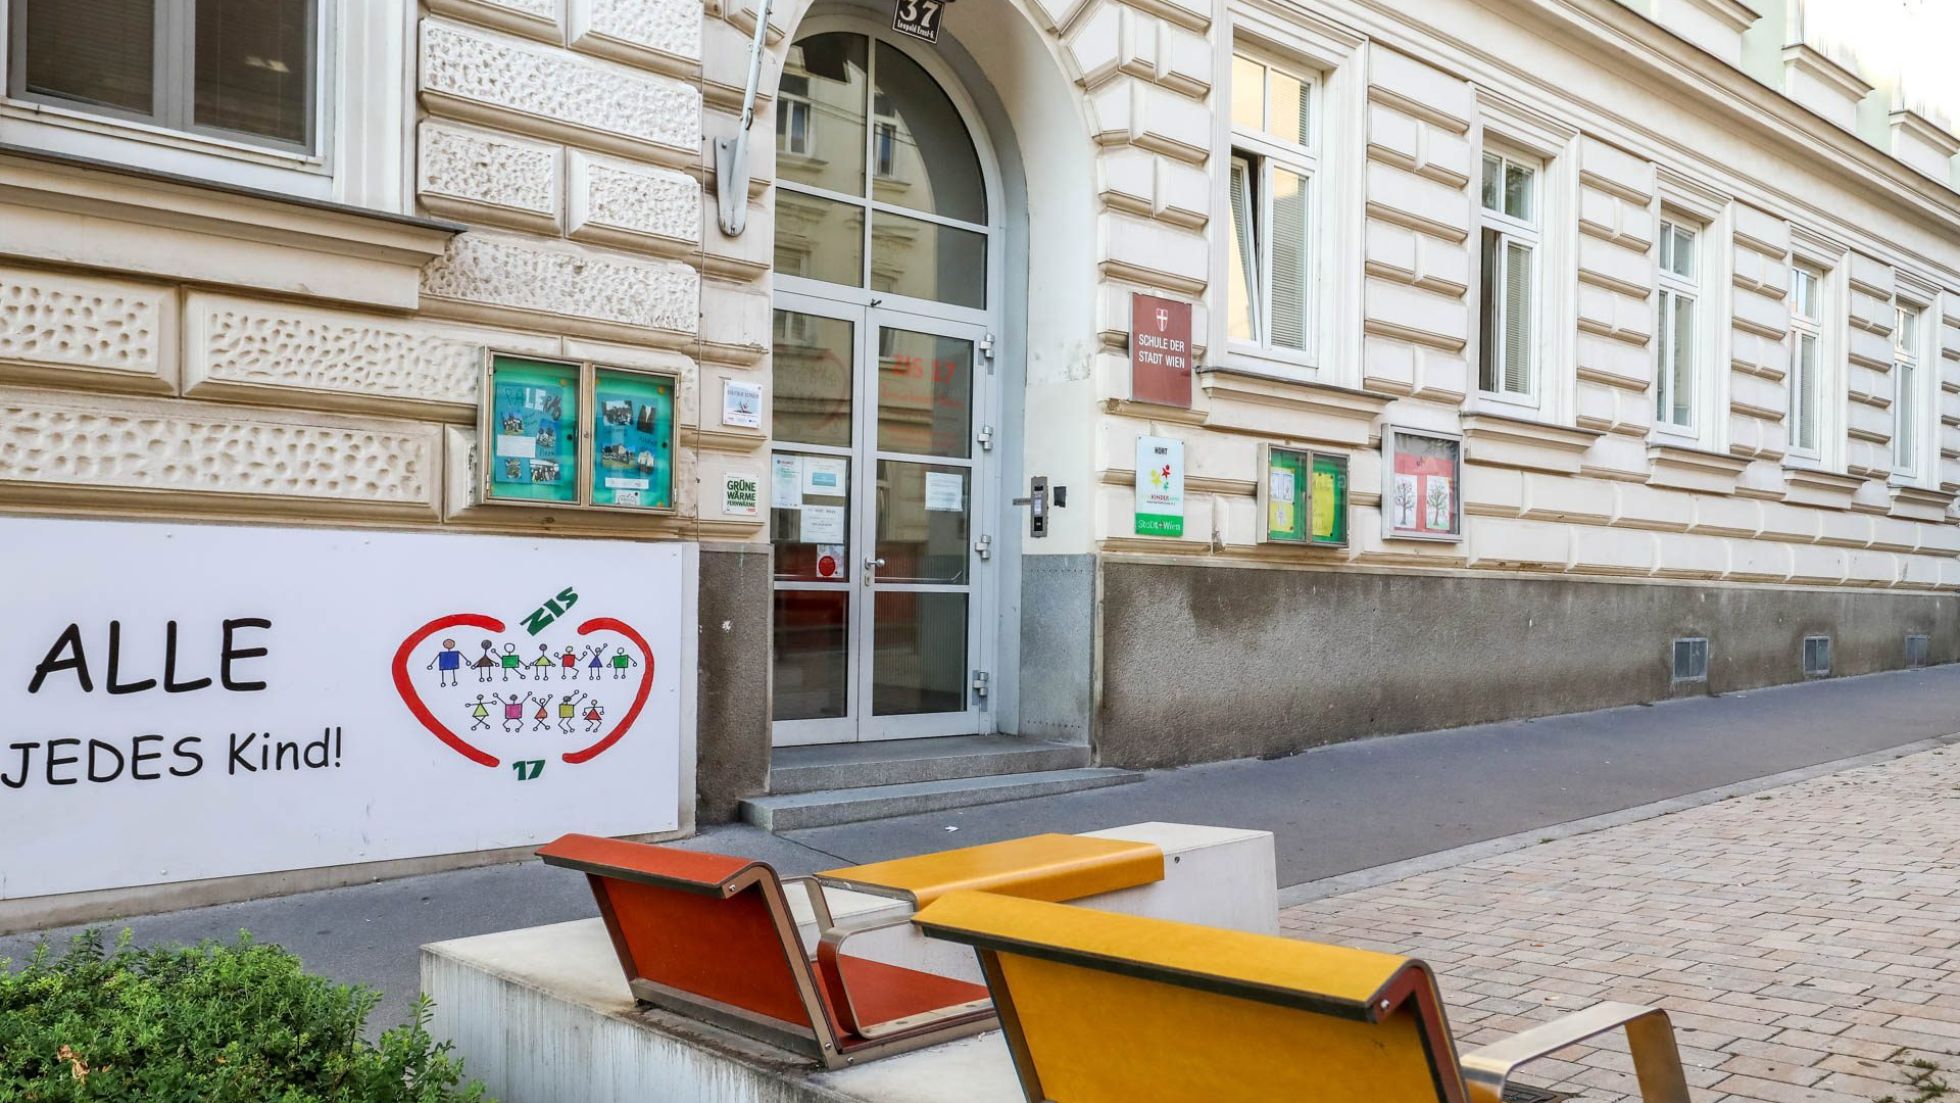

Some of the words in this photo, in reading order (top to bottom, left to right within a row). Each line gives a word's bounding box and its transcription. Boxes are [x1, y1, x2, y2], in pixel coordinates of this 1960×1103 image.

[899, 0, 939, 28] 37
[897, 19, 917, 33] Leopold
[1138, 333, 1168, 350] SCHULE
[1170, 339, 1185, 353] DER
[1138, 350, 1164, 365] STADT
[1165, 354, 1185, 369] WIEN
[727, 479, 756, 492] GRÜNE
[727, 490, 756, 501] WÄRME
[519, 585, 579, 636] ZIS
[28, 617, 272, 695] ALLE
[0, 733, 204, 789] JEDES
[227, 726, 343, 775] Kind!
[511, 758, 547, 782] 17
